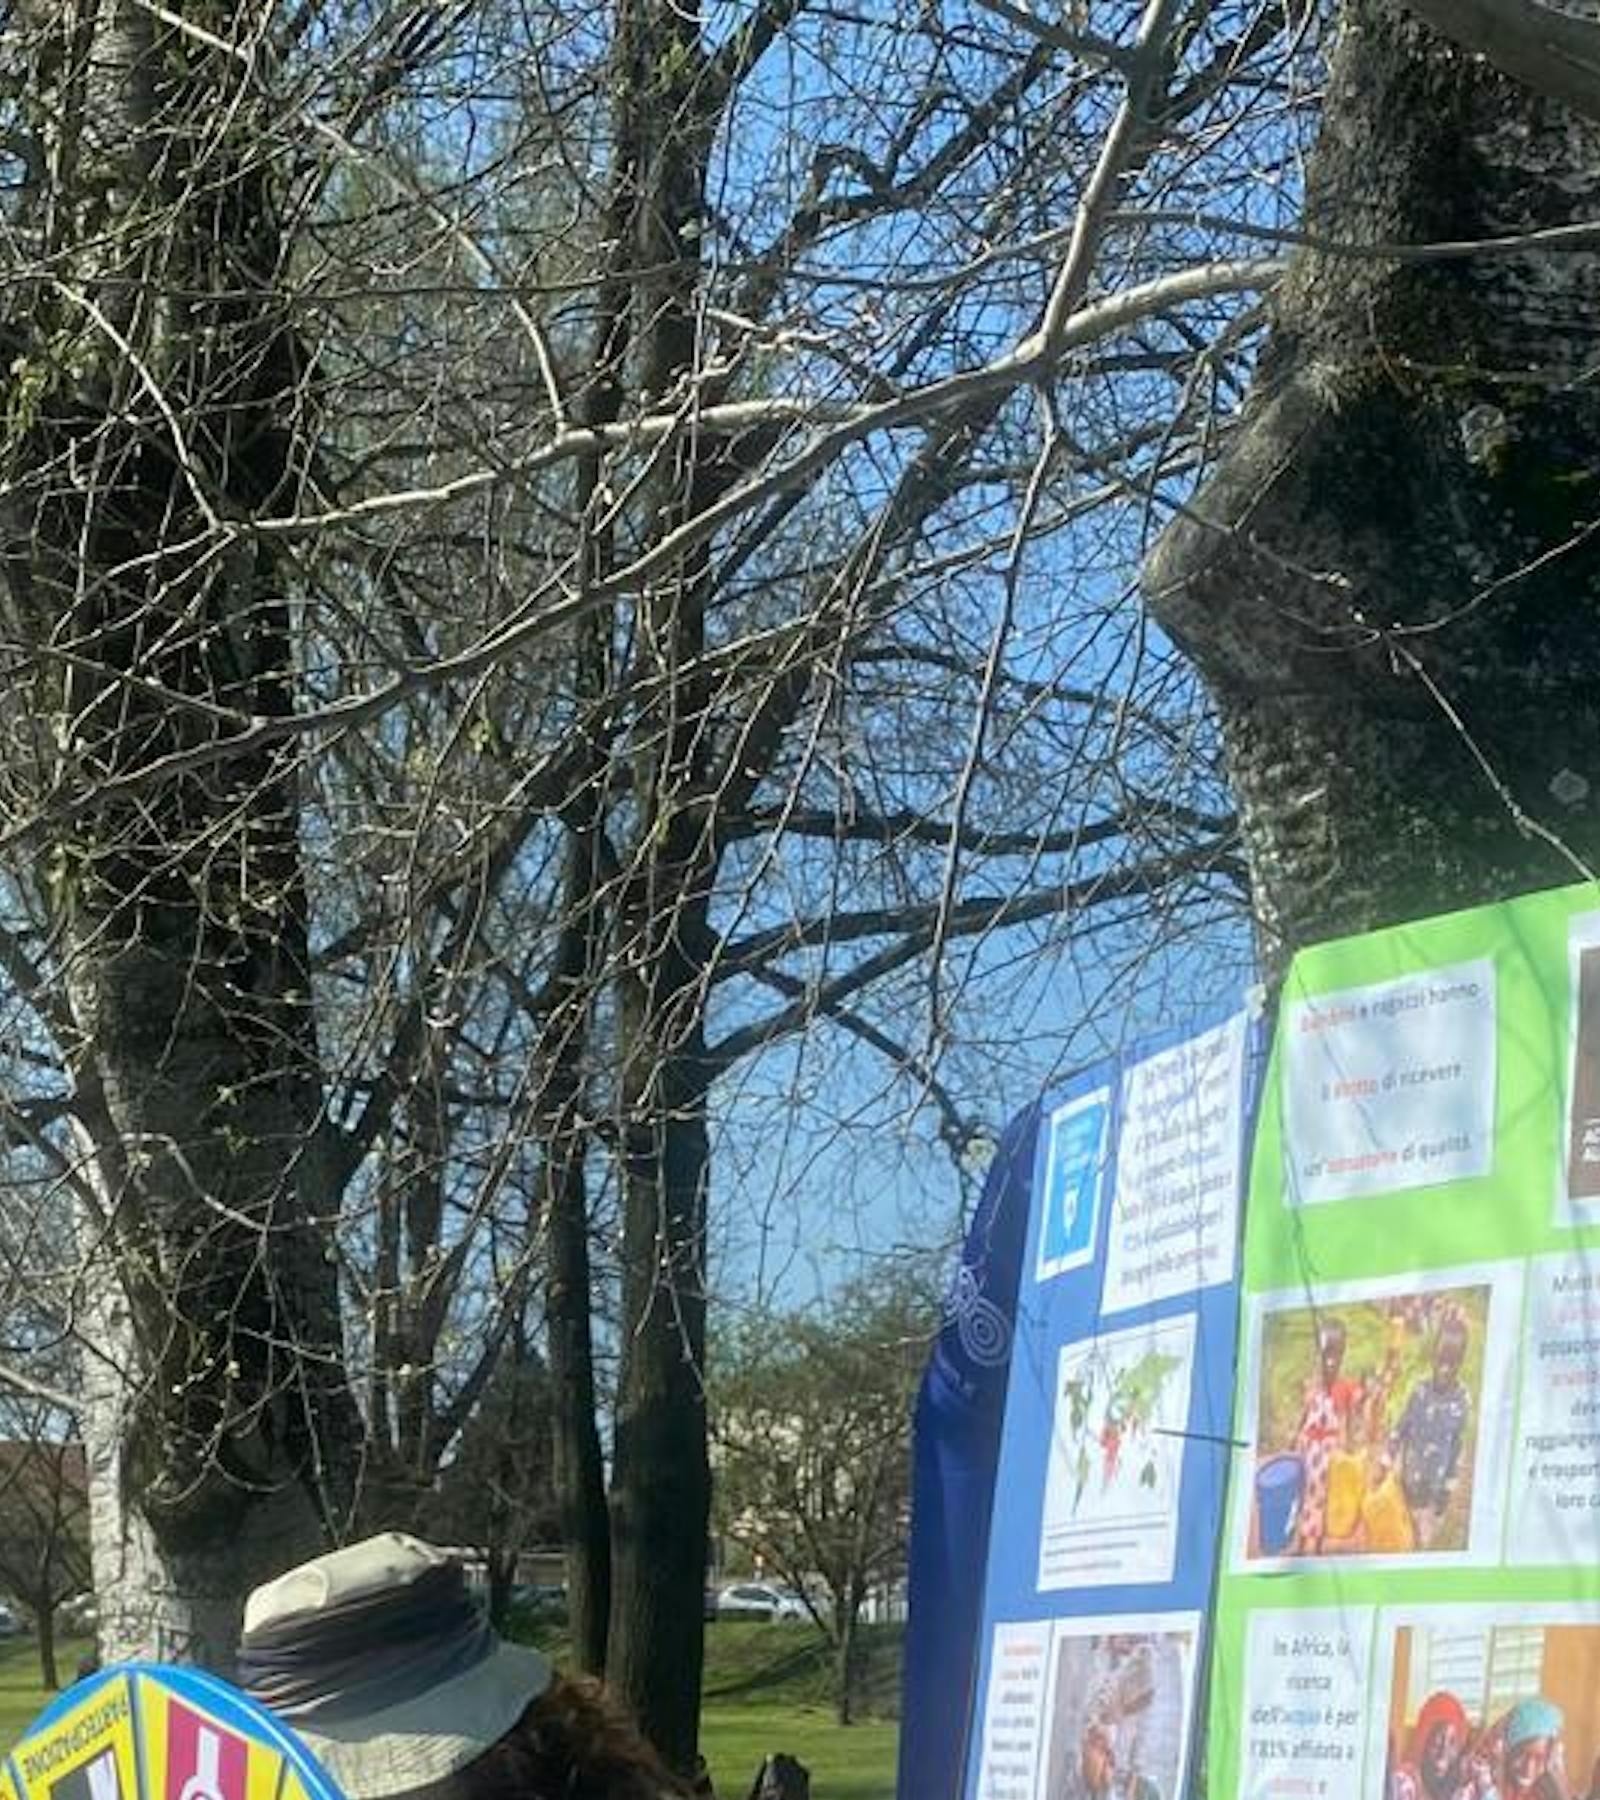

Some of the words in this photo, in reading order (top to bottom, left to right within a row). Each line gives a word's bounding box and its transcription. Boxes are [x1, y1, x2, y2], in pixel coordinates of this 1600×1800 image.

[1430, 983, 1479, 1003] hanno
[1401, 1063, 1461, 1084] ricevere
[1291, 1636, 1334, 1658] Africa,
[1336, 1710, 1359, 1732] per
[24, 1696, 130, 1785] PARTECIPAZIONE
